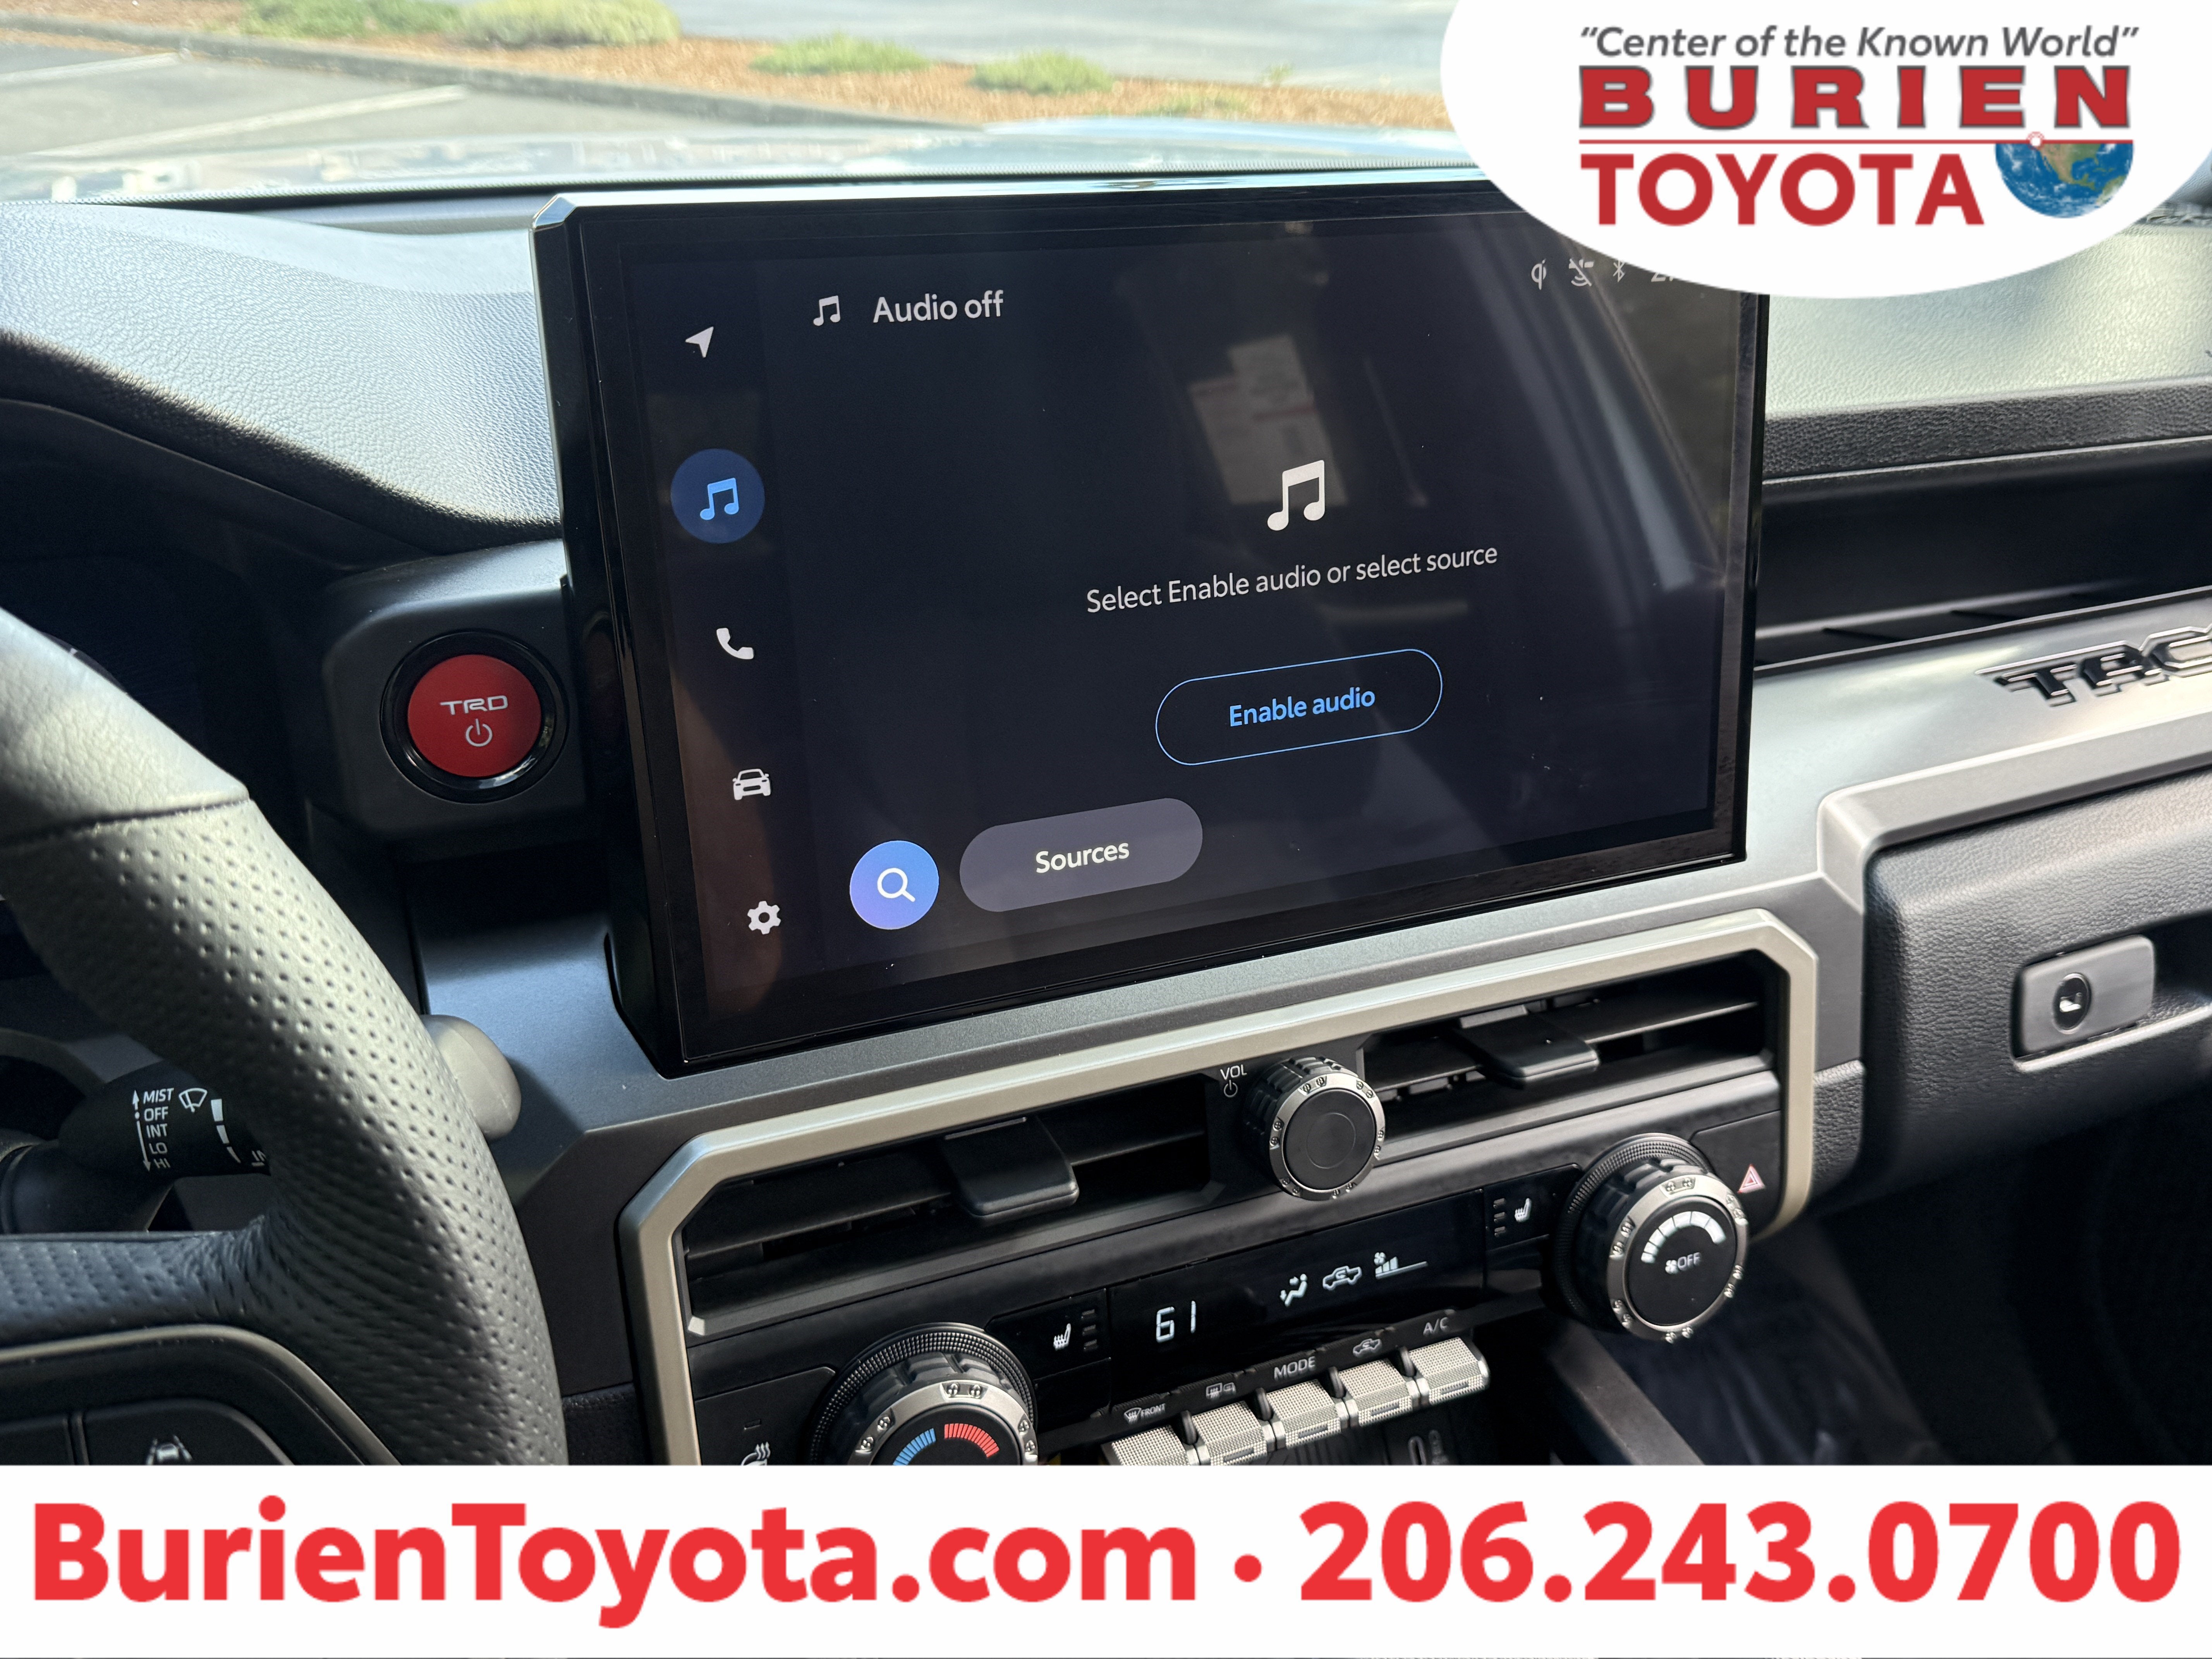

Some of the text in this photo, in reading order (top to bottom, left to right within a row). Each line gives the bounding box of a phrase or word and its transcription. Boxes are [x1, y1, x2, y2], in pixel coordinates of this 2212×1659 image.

[873, 290, 1003, 323] Audio off
[1087, 547, 1498, 613] Select Enable audio or select source
[1975, 625, 2212, 707] TAC
[440, 696, 508, 715] TRD
[1230, 687, 1375, 727] Enable audio
[1036, 843, 1129, 874] Sources
[1220, 1065, 1247, 1080] VOL
[143, 1088, 174, 1104] MIST
[144, 1106, 168, 1121] OFF
[146, 1123, 168, 1139] INT
[149, 1142, 168, 1154] LO
[153, 1158, 171, 1169] HI
[1678, 1252, 1701, 1271] OFF
[1156, 1301, 1196, 1341] 61
[1423, 1317, 1448, 1335] A/C
[1274, 1356, 1315, 1380] MODE
[1141, 1403, 1166, 1419] FRONT
